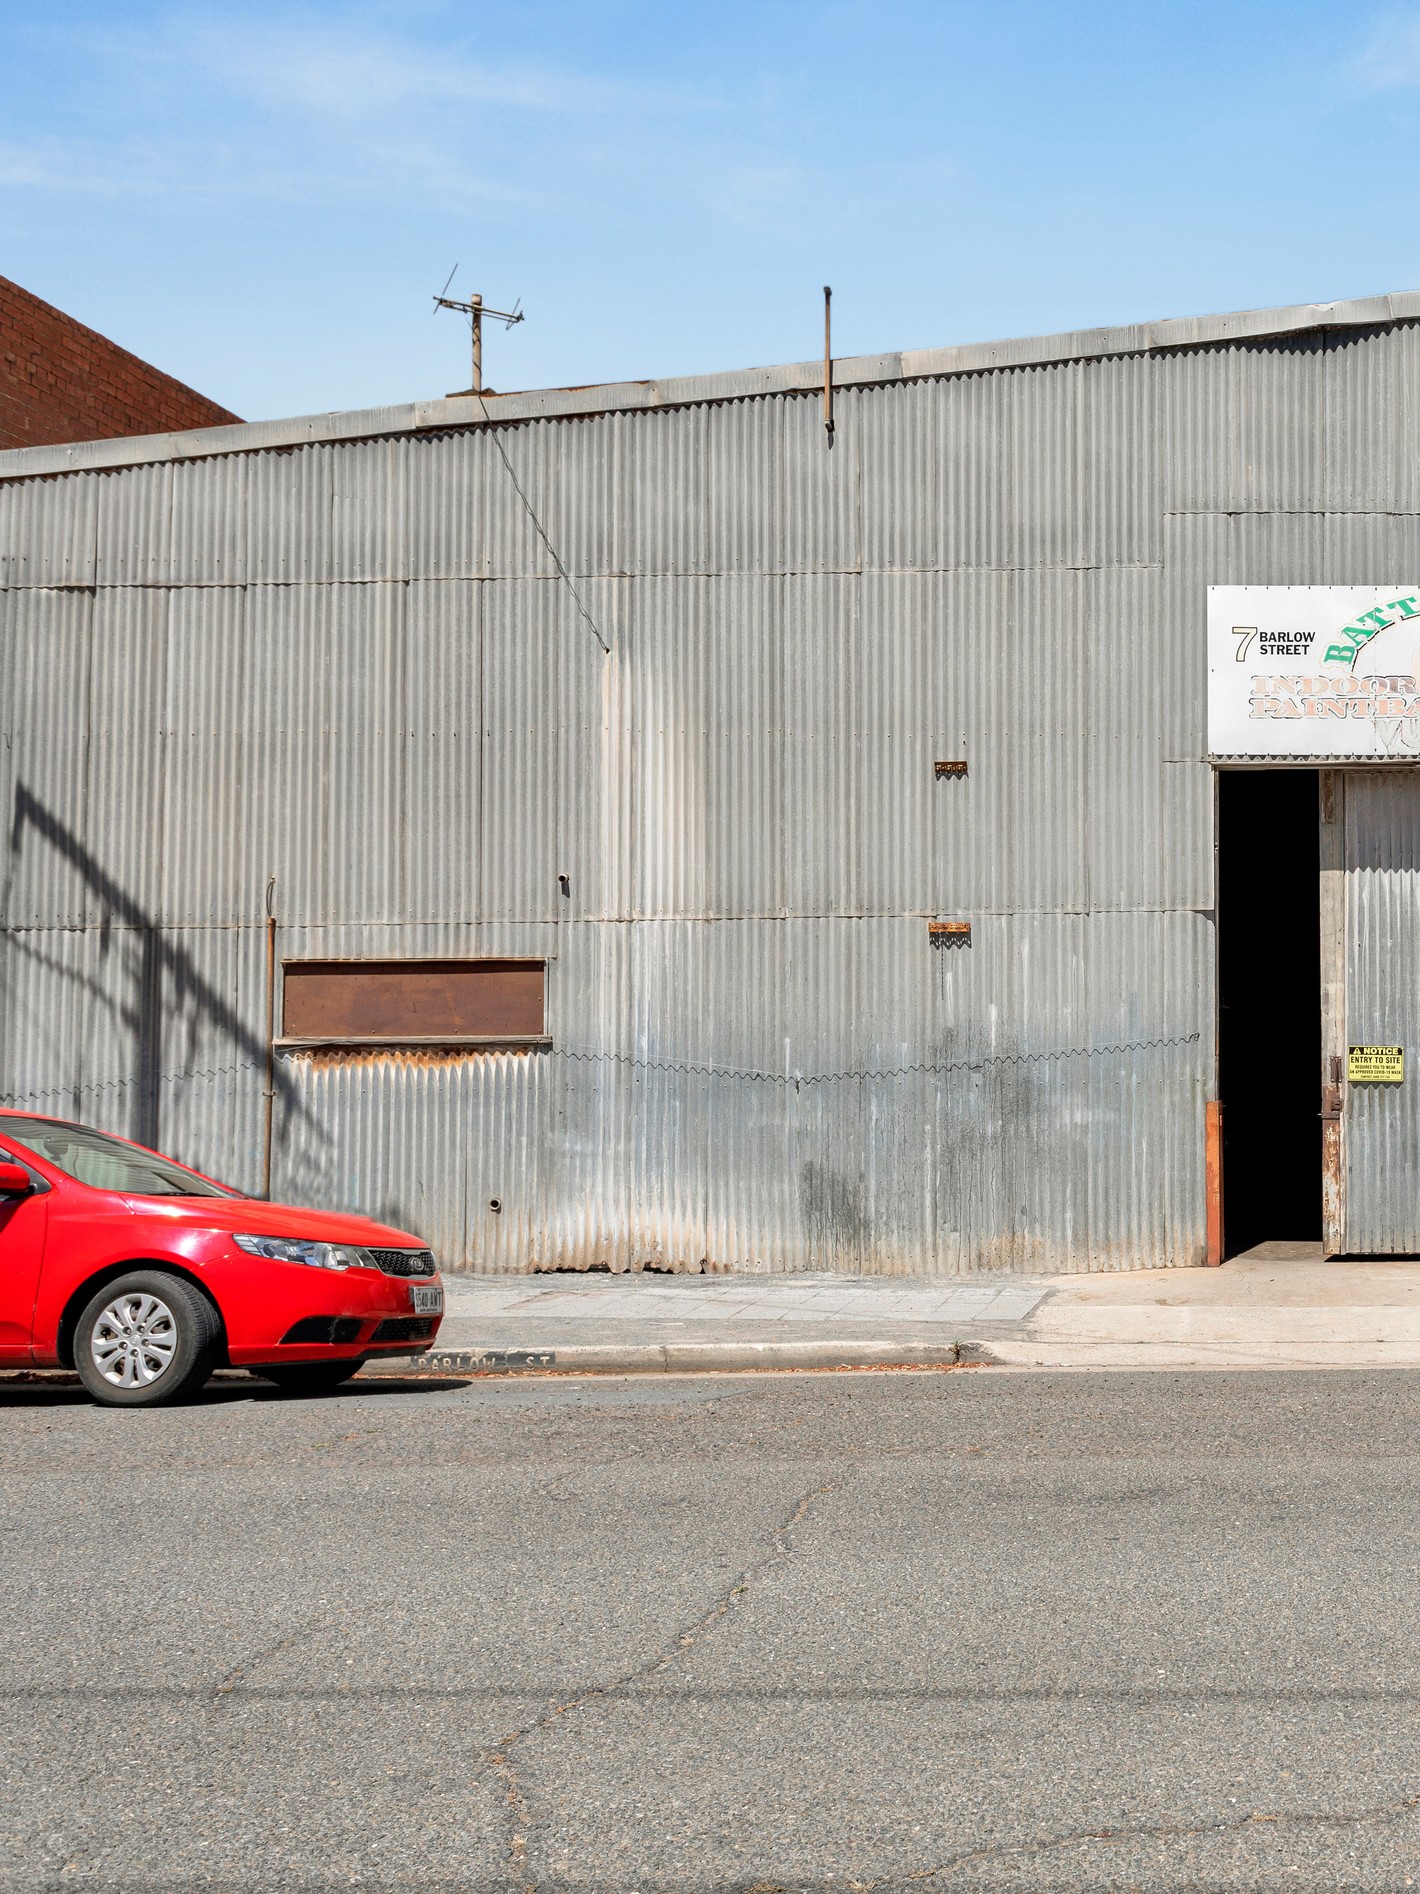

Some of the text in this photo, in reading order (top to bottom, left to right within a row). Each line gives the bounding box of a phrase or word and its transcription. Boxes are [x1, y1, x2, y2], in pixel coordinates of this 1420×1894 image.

[1259, 632, 1316, 643] BARLOW
[1232, 627, 1258, 662] 7
[1259, 644, 1310, 655] STREET
[1250, 675, 1417, 696] INDOOR
[1363, 1047, 1398, 1055] NOTICE
[1350, 1056, 1401, 1064] ENTRY TO SITE
[525, 1355, 550, 1370] ST
